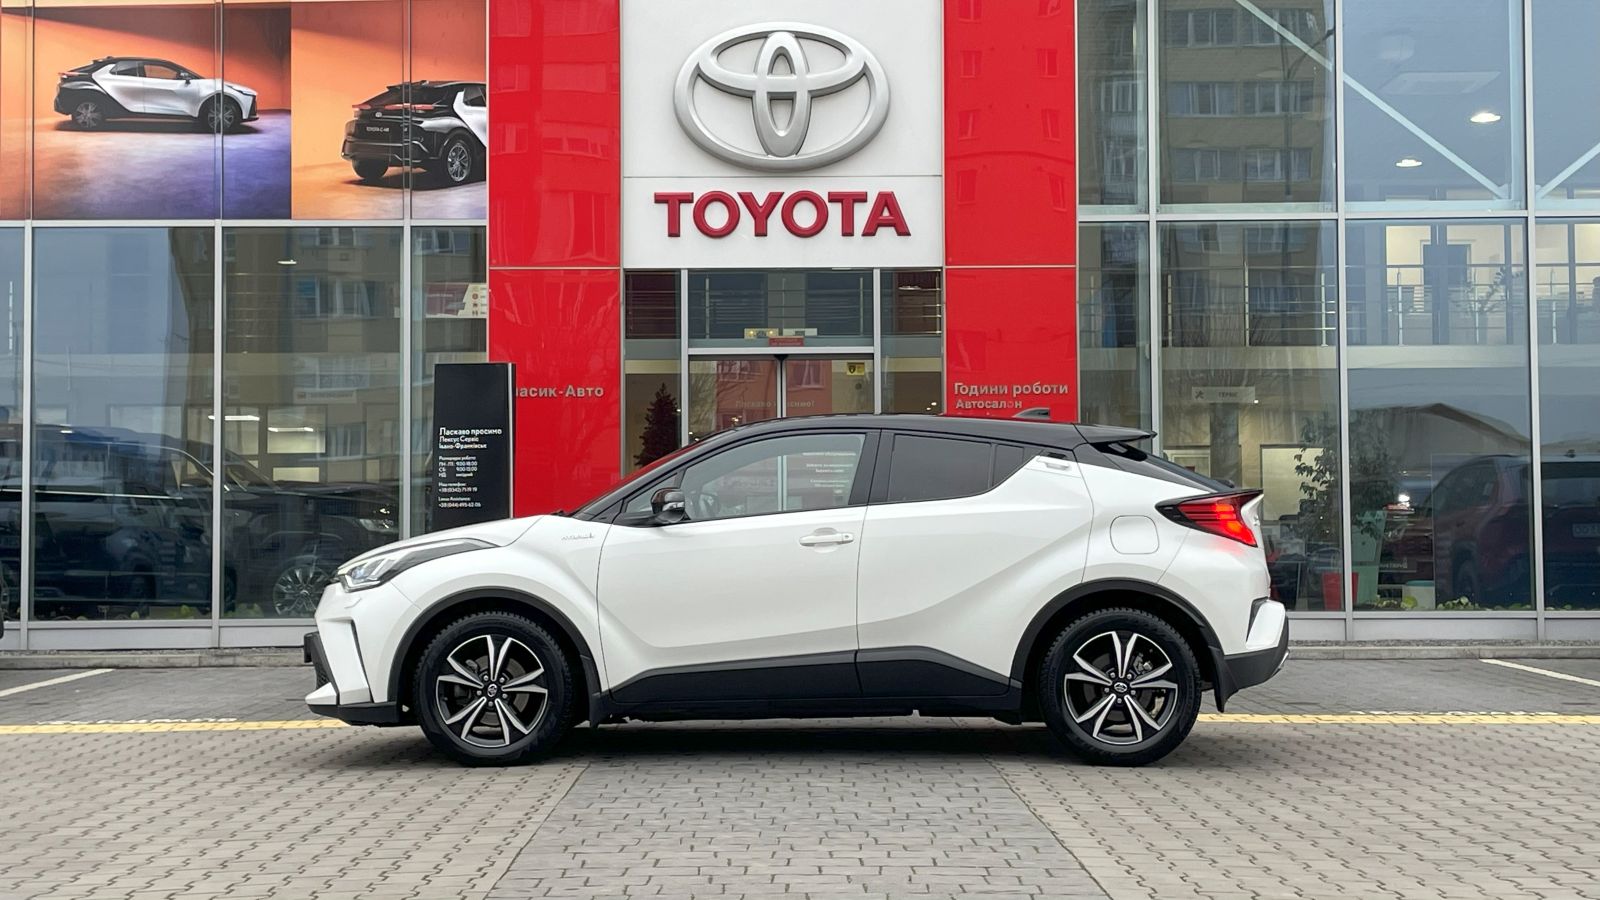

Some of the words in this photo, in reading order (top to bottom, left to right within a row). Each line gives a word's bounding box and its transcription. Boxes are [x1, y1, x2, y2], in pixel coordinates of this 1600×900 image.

[654, 190, 911, 239] TOYOTA
[515, 385, 604, 397] асик-Авто
[954, 382, 1008, 396] Години
[1013, 381, 1068, 397] роботи
[955, 400, 1022, 409] Автосалон
[439, 427, 470, 435] Ласкаво
[471, 428, 502, 436] просимо
